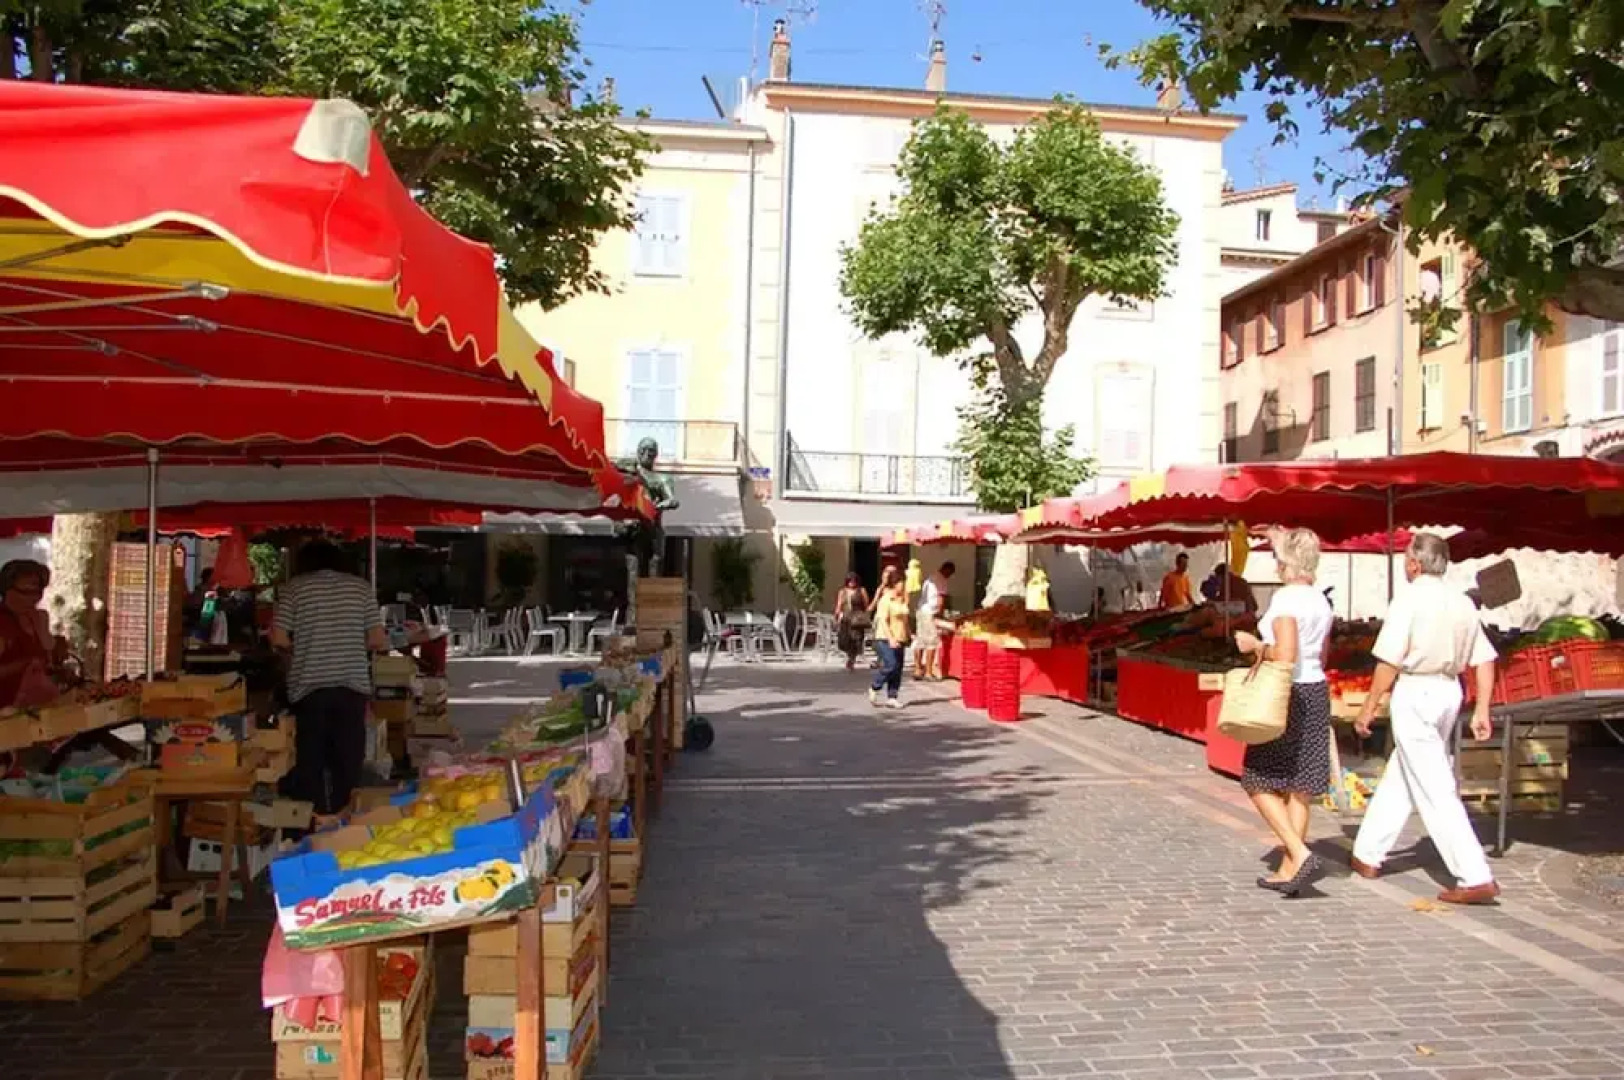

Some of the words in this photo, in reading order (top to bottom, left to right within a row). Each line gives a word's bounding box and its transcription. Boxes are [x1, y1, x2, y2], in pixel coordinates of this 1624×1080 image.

[294, 889, 385, 926] Samuel
[388, 897, 403, 910] et
[408, 884, 446, 909] Fils
